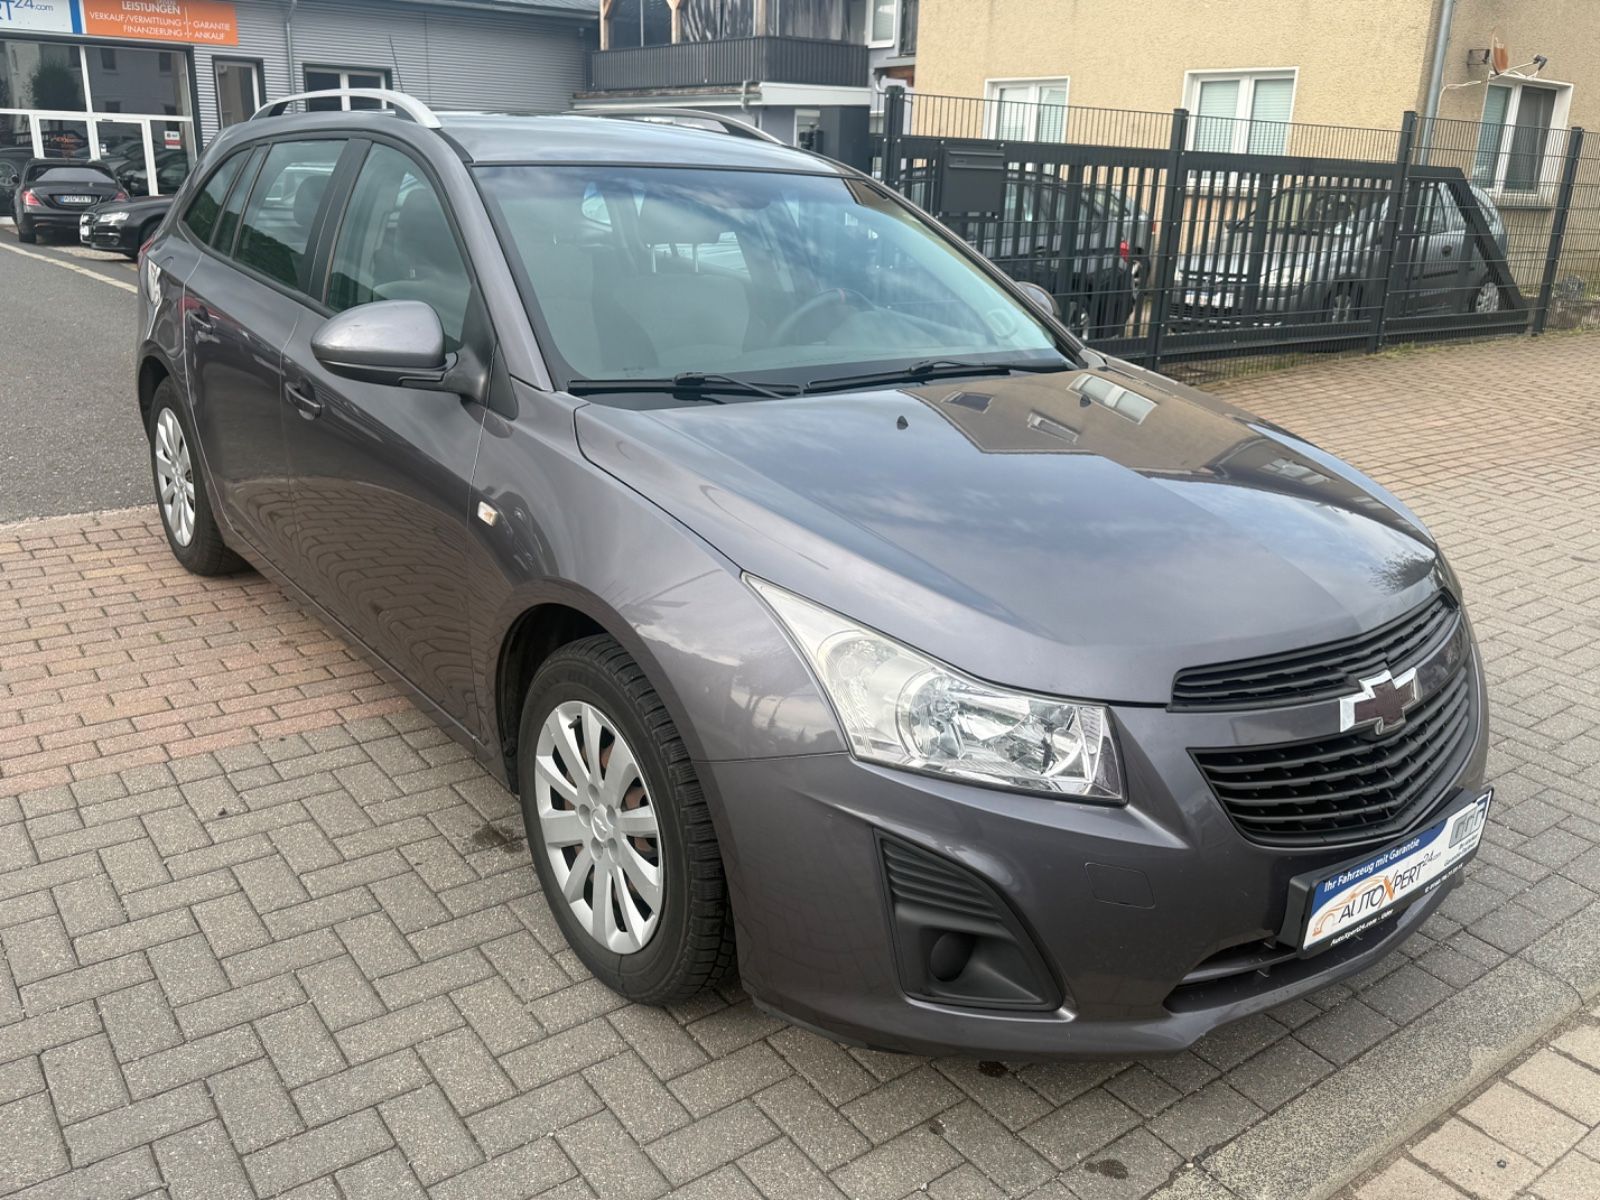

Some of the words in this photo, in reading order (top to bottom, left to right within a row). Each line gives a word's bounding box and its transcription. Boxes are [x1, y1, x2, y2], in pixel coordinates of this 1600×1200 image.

[122, 1, 181, 15] LEISTUNGEN
[89, 12, 182, 27] VERKAUF/VERMITTLUNG
[193, 20, 230, 31] GARANTIE
[123, 25, 183, 37] FINANZIERUNG
[194, 32, 225, 40] ANKAUF
[1324, 878, 1336, 892] Ihr
[1337, 862, 1375, 886] Fahrzeug
[1375, 854, 1388, 868] mit
[1389, 837, 1420, 860] Garantie
